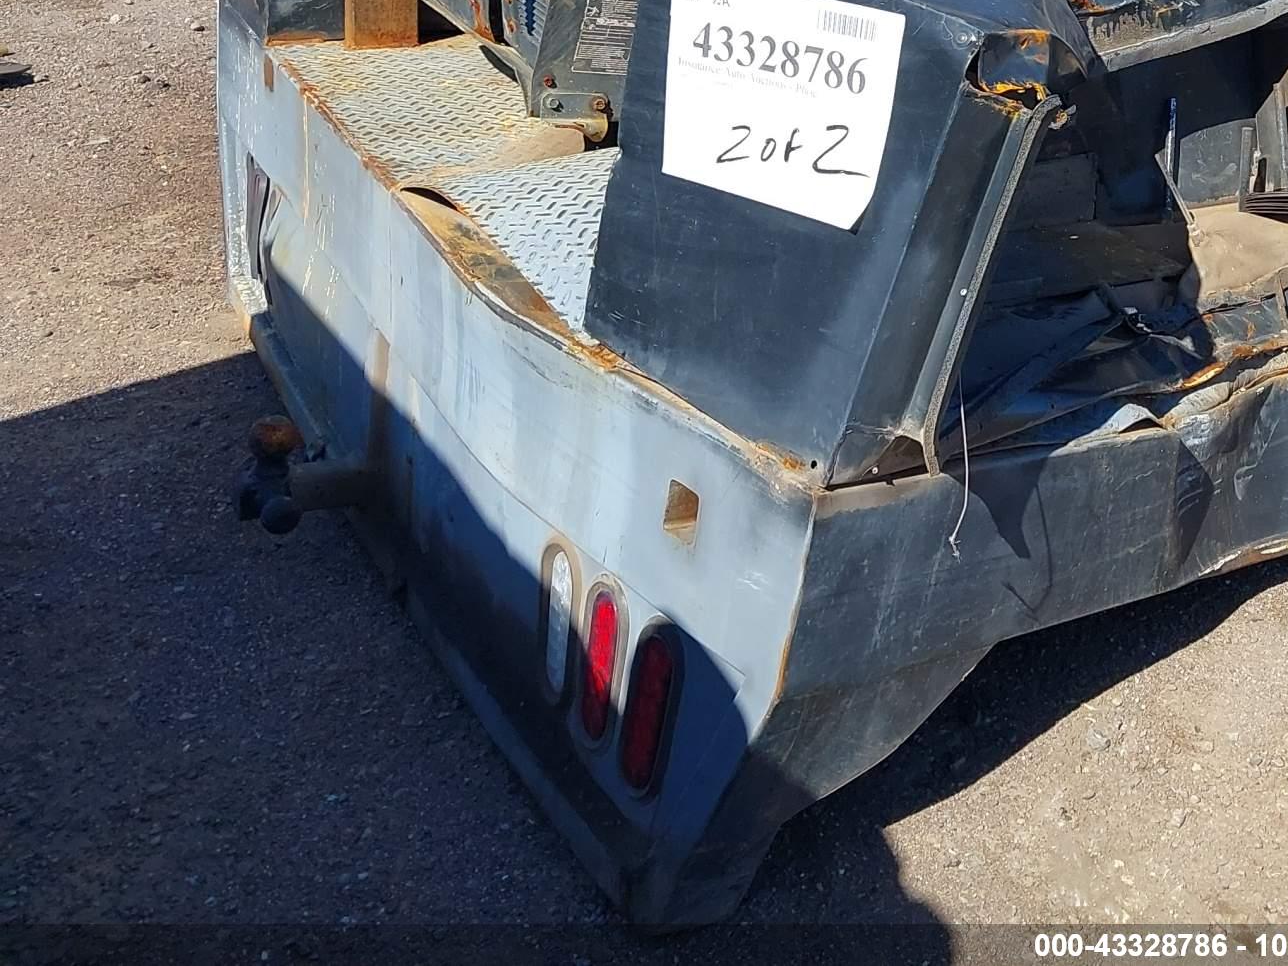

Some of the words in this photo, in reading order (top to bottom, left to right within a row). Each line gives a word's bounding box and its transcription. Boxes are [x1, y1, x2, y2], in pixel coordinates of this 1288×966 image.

[678, 56, 721, 76] Insurance
[726, 67, 746, 81] Auto
[692, 22, 869, 95] 43328786
[716, 125, 751, 163] 2
[761, 128, 803, 162] of
[812, 125, 870, 178] 2
